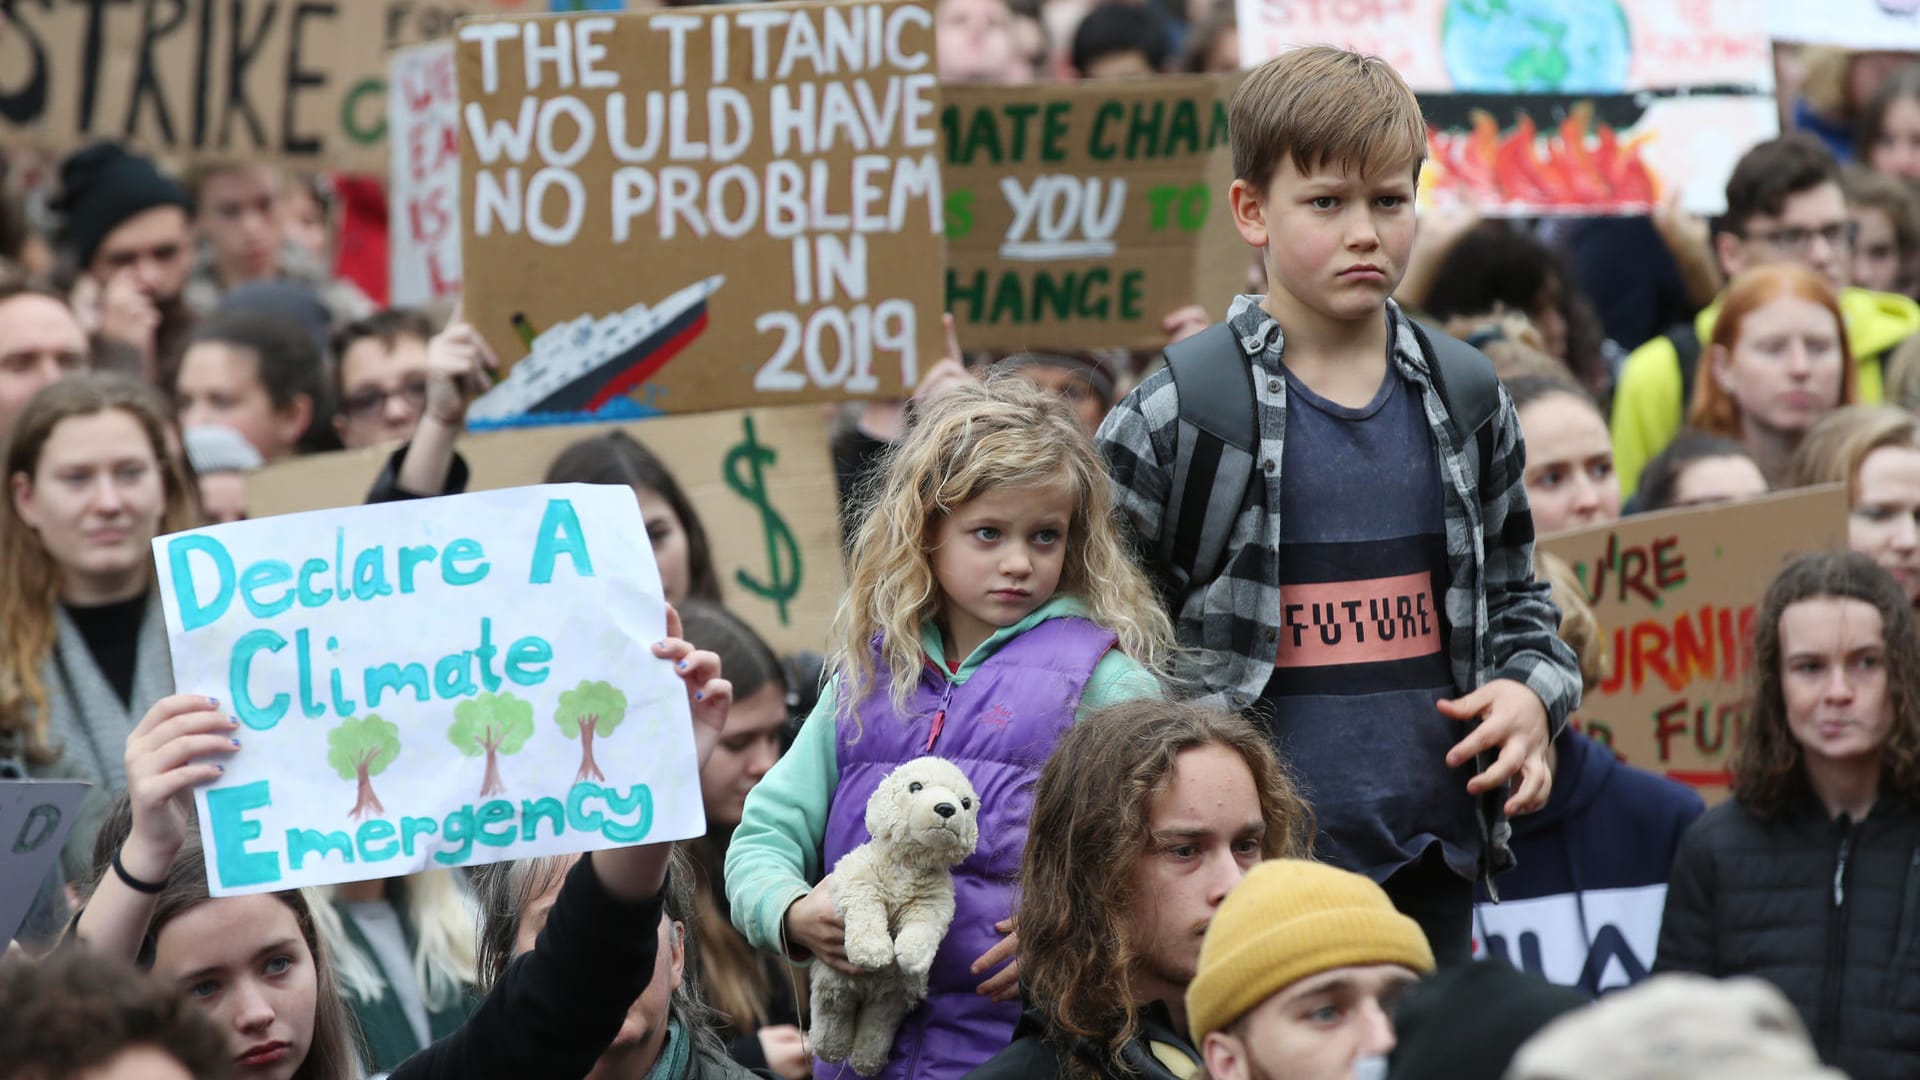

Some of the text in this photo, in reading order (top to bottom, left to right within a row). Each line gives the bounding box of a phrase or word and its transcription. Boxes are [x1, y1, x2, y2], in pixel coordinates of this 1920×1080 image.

[0, 0, 338, 155] STRIKE
[459, 5, 934, 94] THE TITANIC
[465, 74, 937, 167] WOULD HAVE
[474, 152, 944, 246] NO PROBLEM
[1000, 173, 1128, 241] YOU
[1148, 183, 1211, 231] TO
[792, 233, 868, 304] IN
[754, 299, 917, 392] 2019
[167, 499, 595, 632] Declare A
[1285, 592, 1432, 647] FUTURE
[230, 617, 552, 730] Climate
